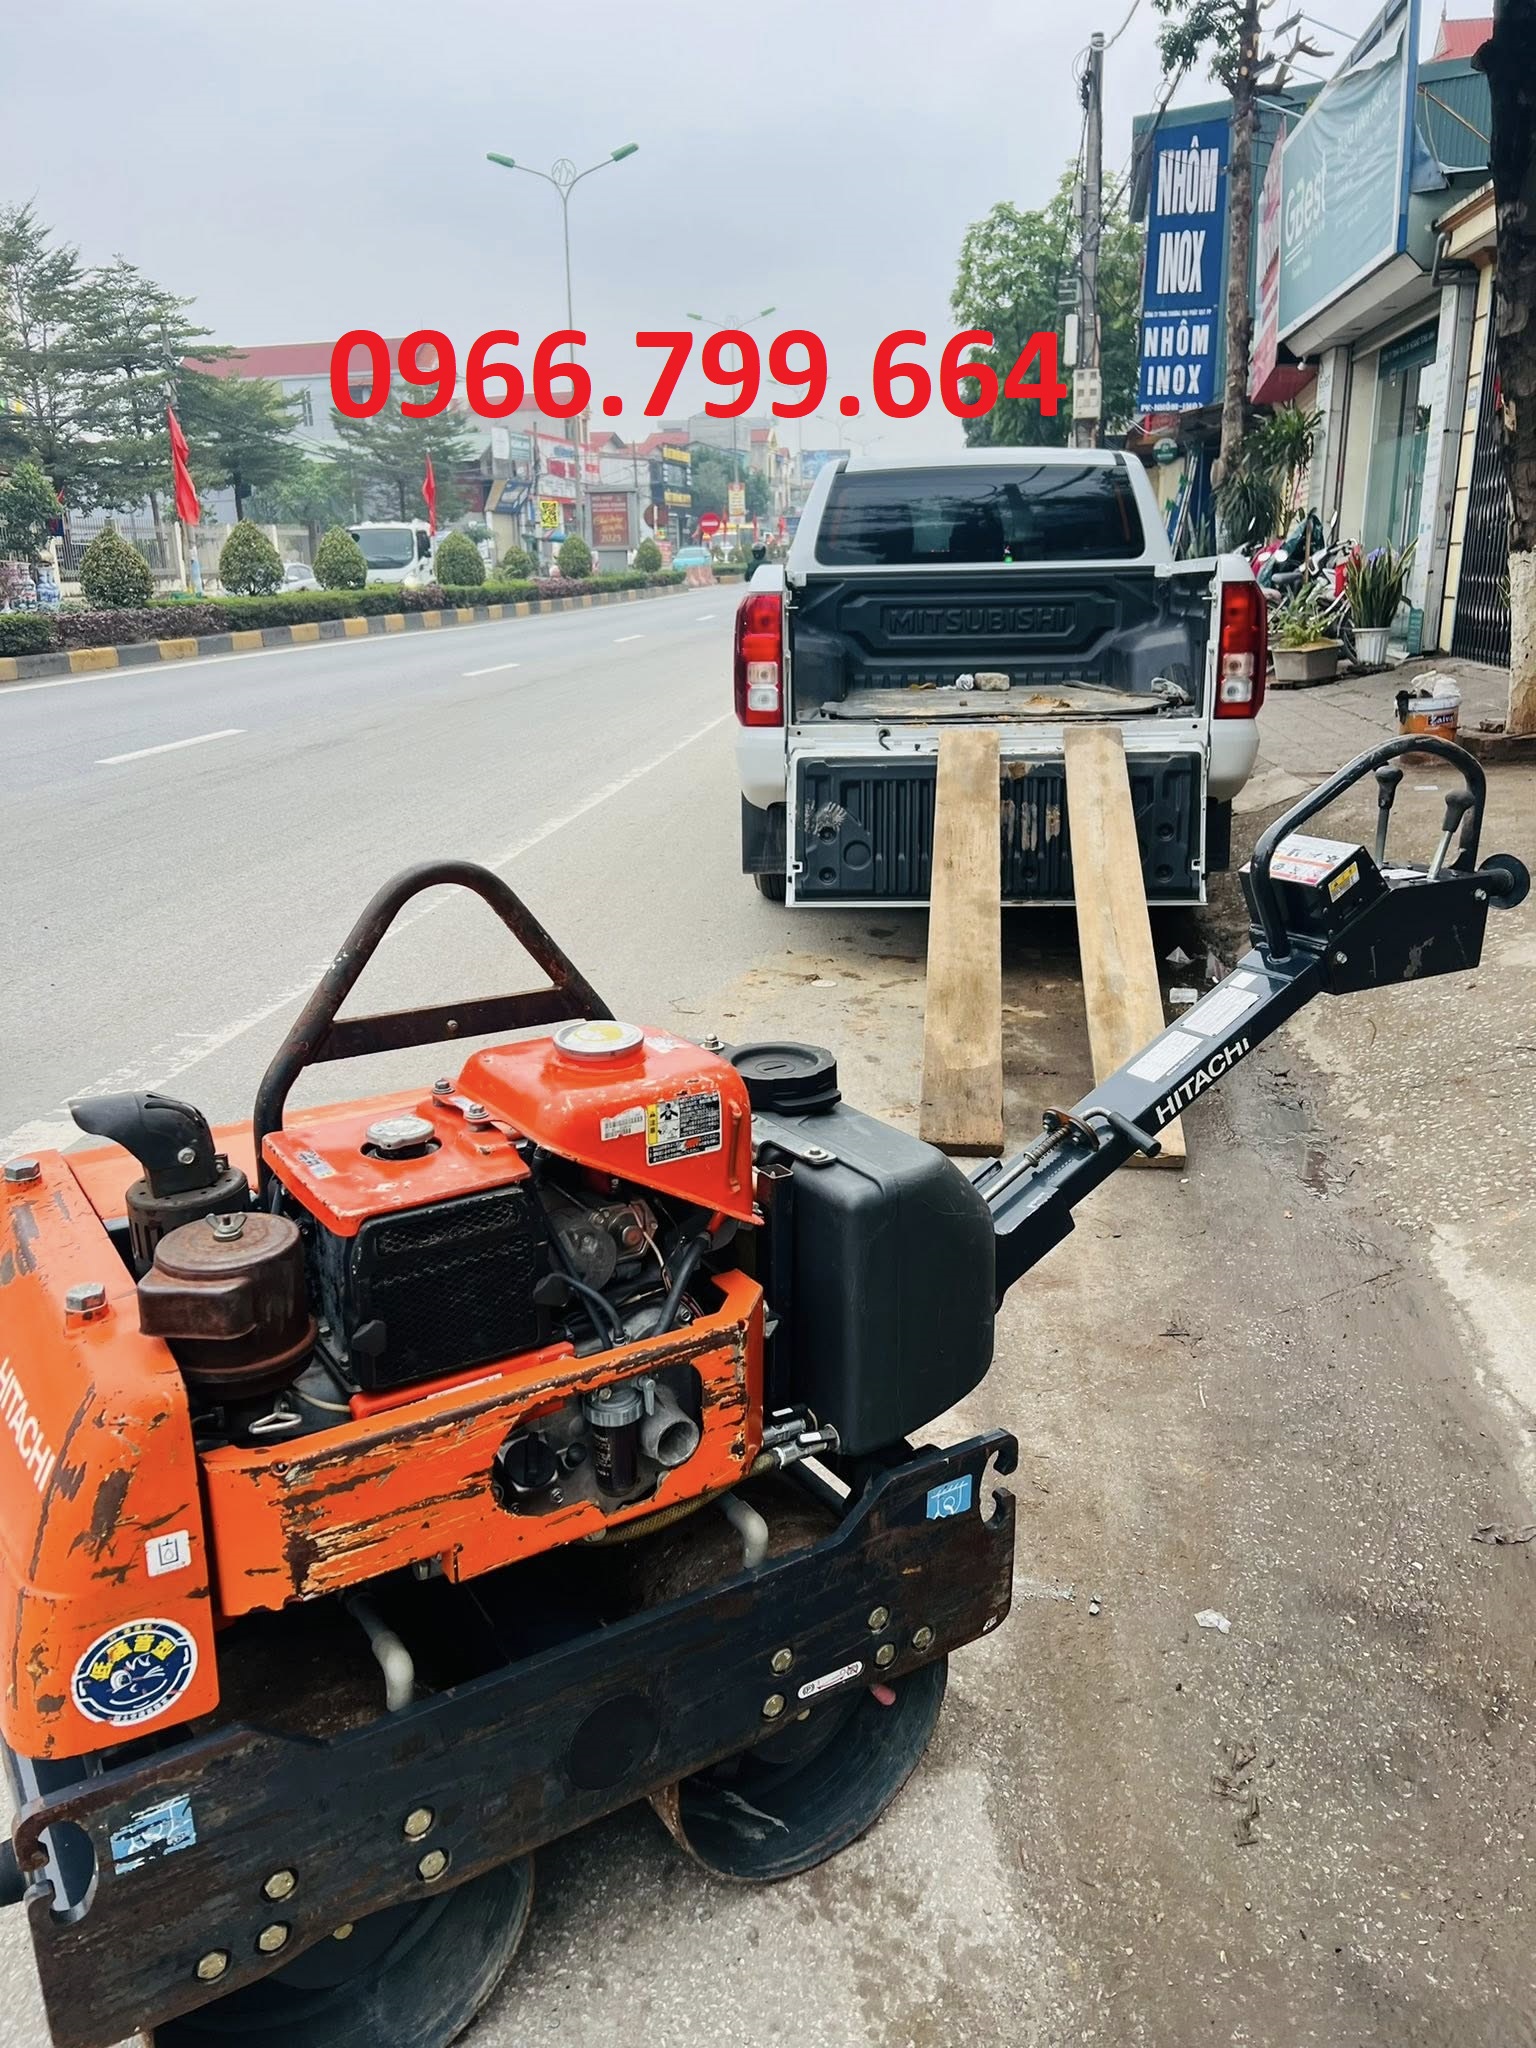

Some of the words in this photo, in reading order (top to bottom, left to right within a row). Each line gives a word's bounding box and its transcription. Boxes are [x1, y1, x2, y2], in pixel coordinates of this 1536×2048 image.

[1156, 135, 1219, 217] NHÔM
[1156, 230, 1206, 295] INOX
[1144, 318, 1210, 358] NHÔM
[1146, 364, 1202, 396] INOX
[889, 607, 1066, 635] MITSUBISHI
[1155, 1037, 1250, 1125] HITACHI
[0, 1356, 57, 1494] HITACHI
